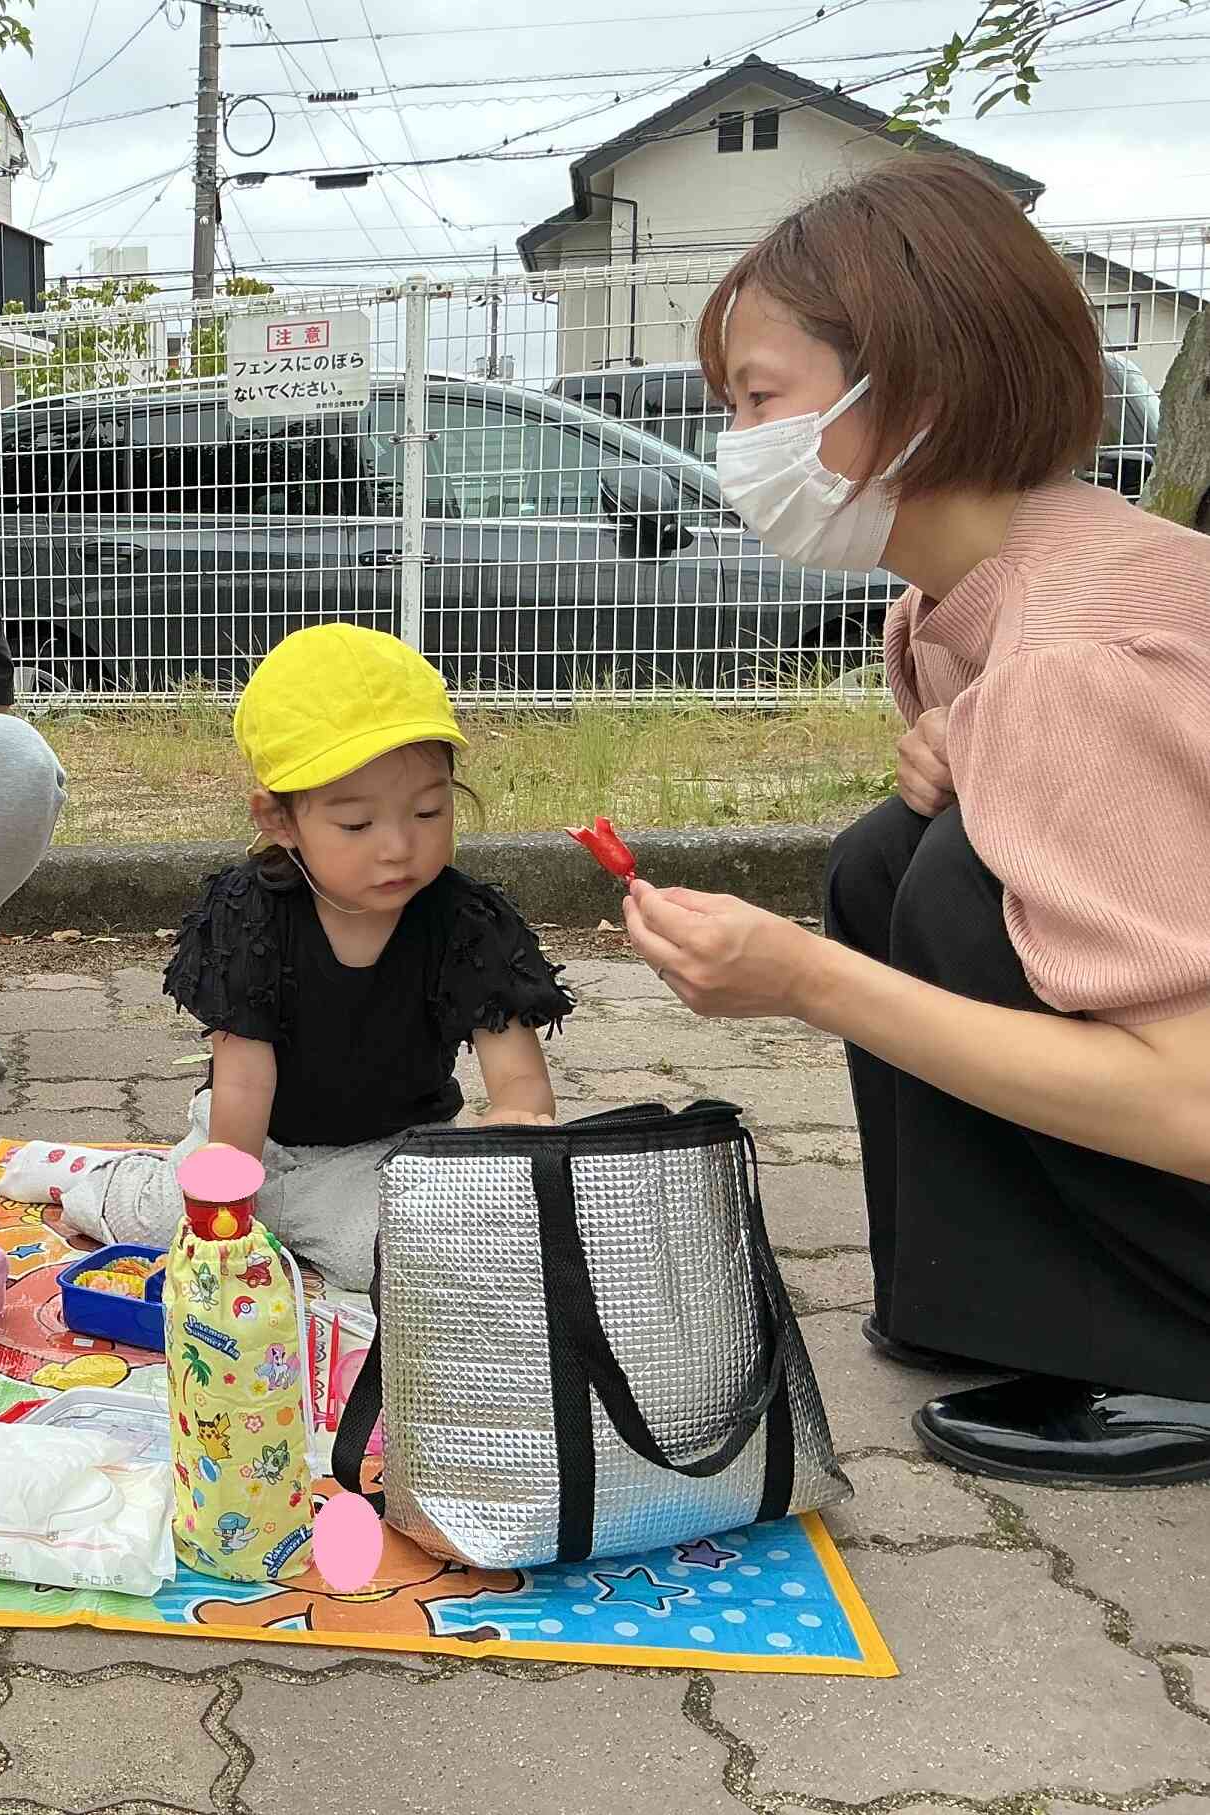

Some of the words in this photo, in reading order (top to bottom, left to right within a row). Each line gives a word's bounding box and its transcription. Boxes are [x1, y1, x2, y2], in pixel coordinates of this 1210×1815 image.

[276, 326, 321, 346] 注意
[233, 352, 364, 377] フェンスにのぼら
[234, 381, 343, 402] ないでください。
